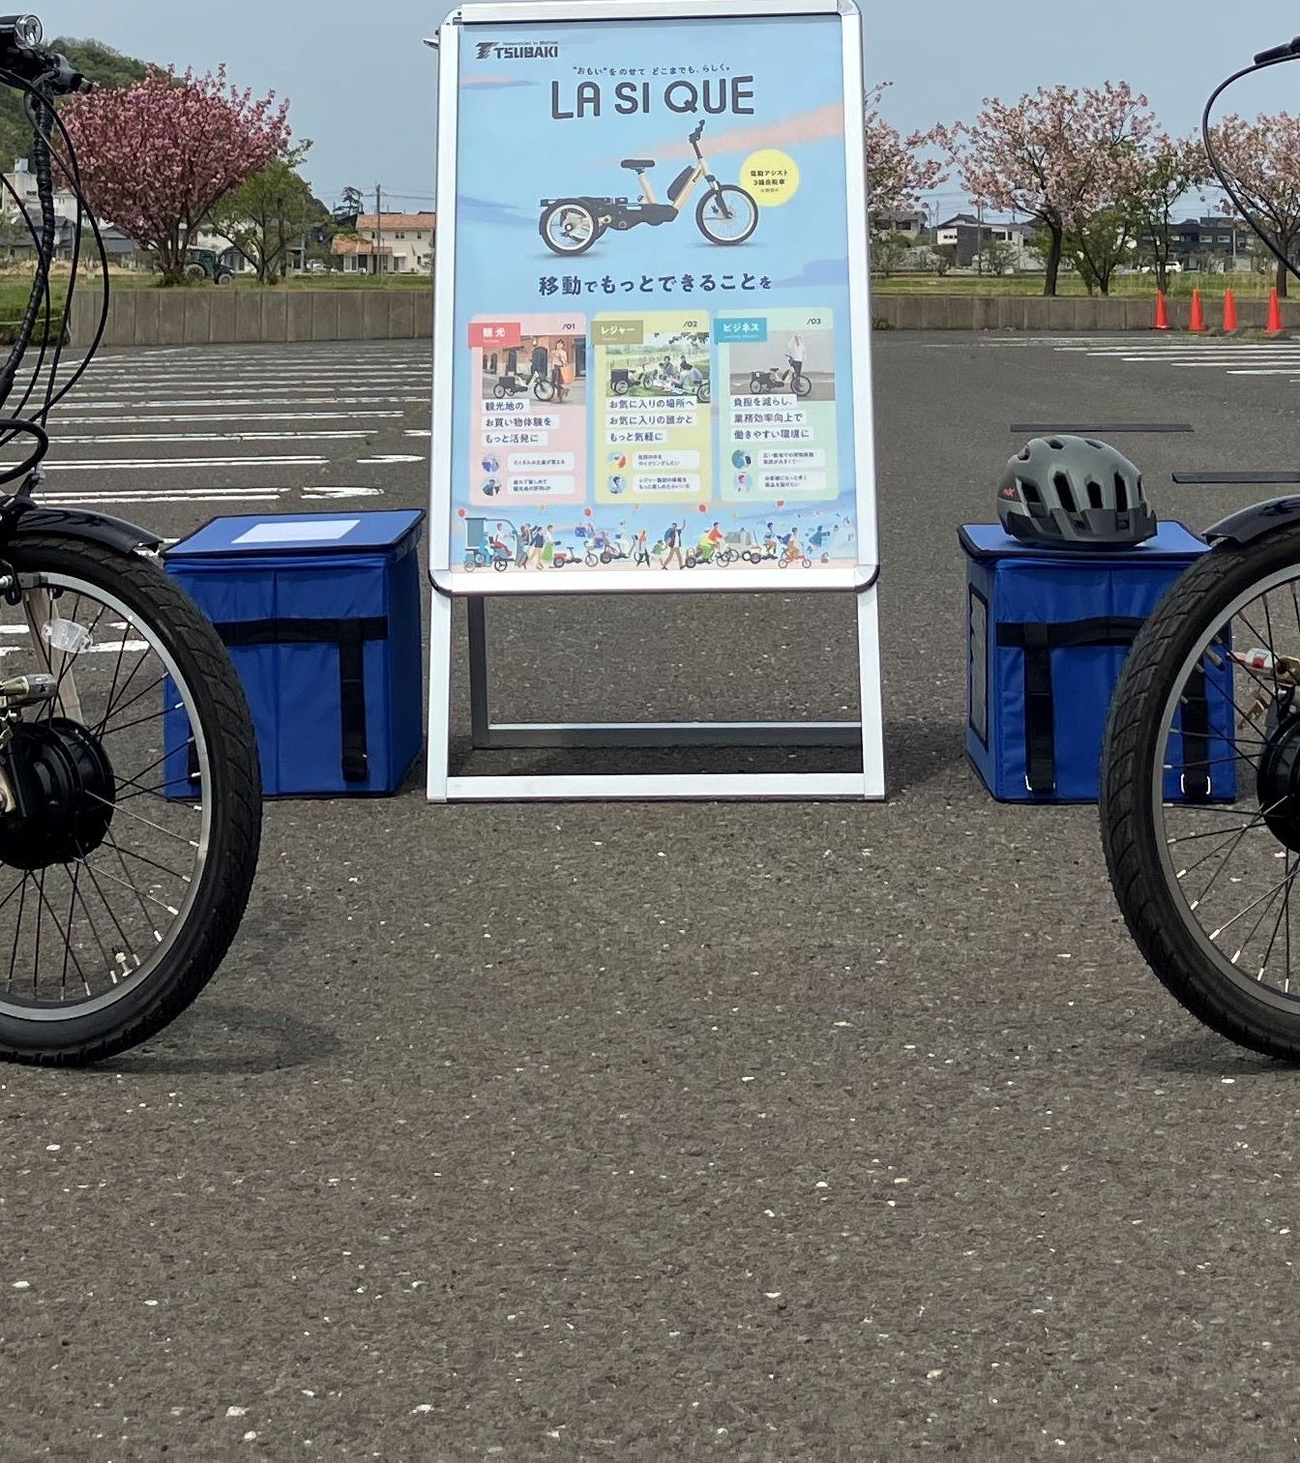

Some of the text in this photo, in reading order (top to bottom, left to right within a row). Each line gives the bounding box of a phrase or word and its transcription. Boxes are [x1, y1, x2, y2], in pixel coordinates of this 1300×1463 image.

[493, 46, 559, 59] TSUBAKI
[551, 75, 755, 120] LA SI QUE
[538, 273, 772, 297] 移動でもっとできることを
[482, 327, 506, 338] 観光
[601, 325, 636, 335] レジャー
[722, 321, 761, 333] ビジネス
[485, 401, 525, 412] 観光地の
[609, 398, 695, 410] お気に入りの場所へ
[485, 417, 552, 428] お買い物体験を
[609, 415, 693, 426] お気に入りの誰かと
[733, 412, 803, 424] 業務効率向上で
[485, 433, 539, 444] もっと活発に
[609, 431, 663, 443] もっと気軽に
[733, 429, 810, 440] 働きやすい環境に
